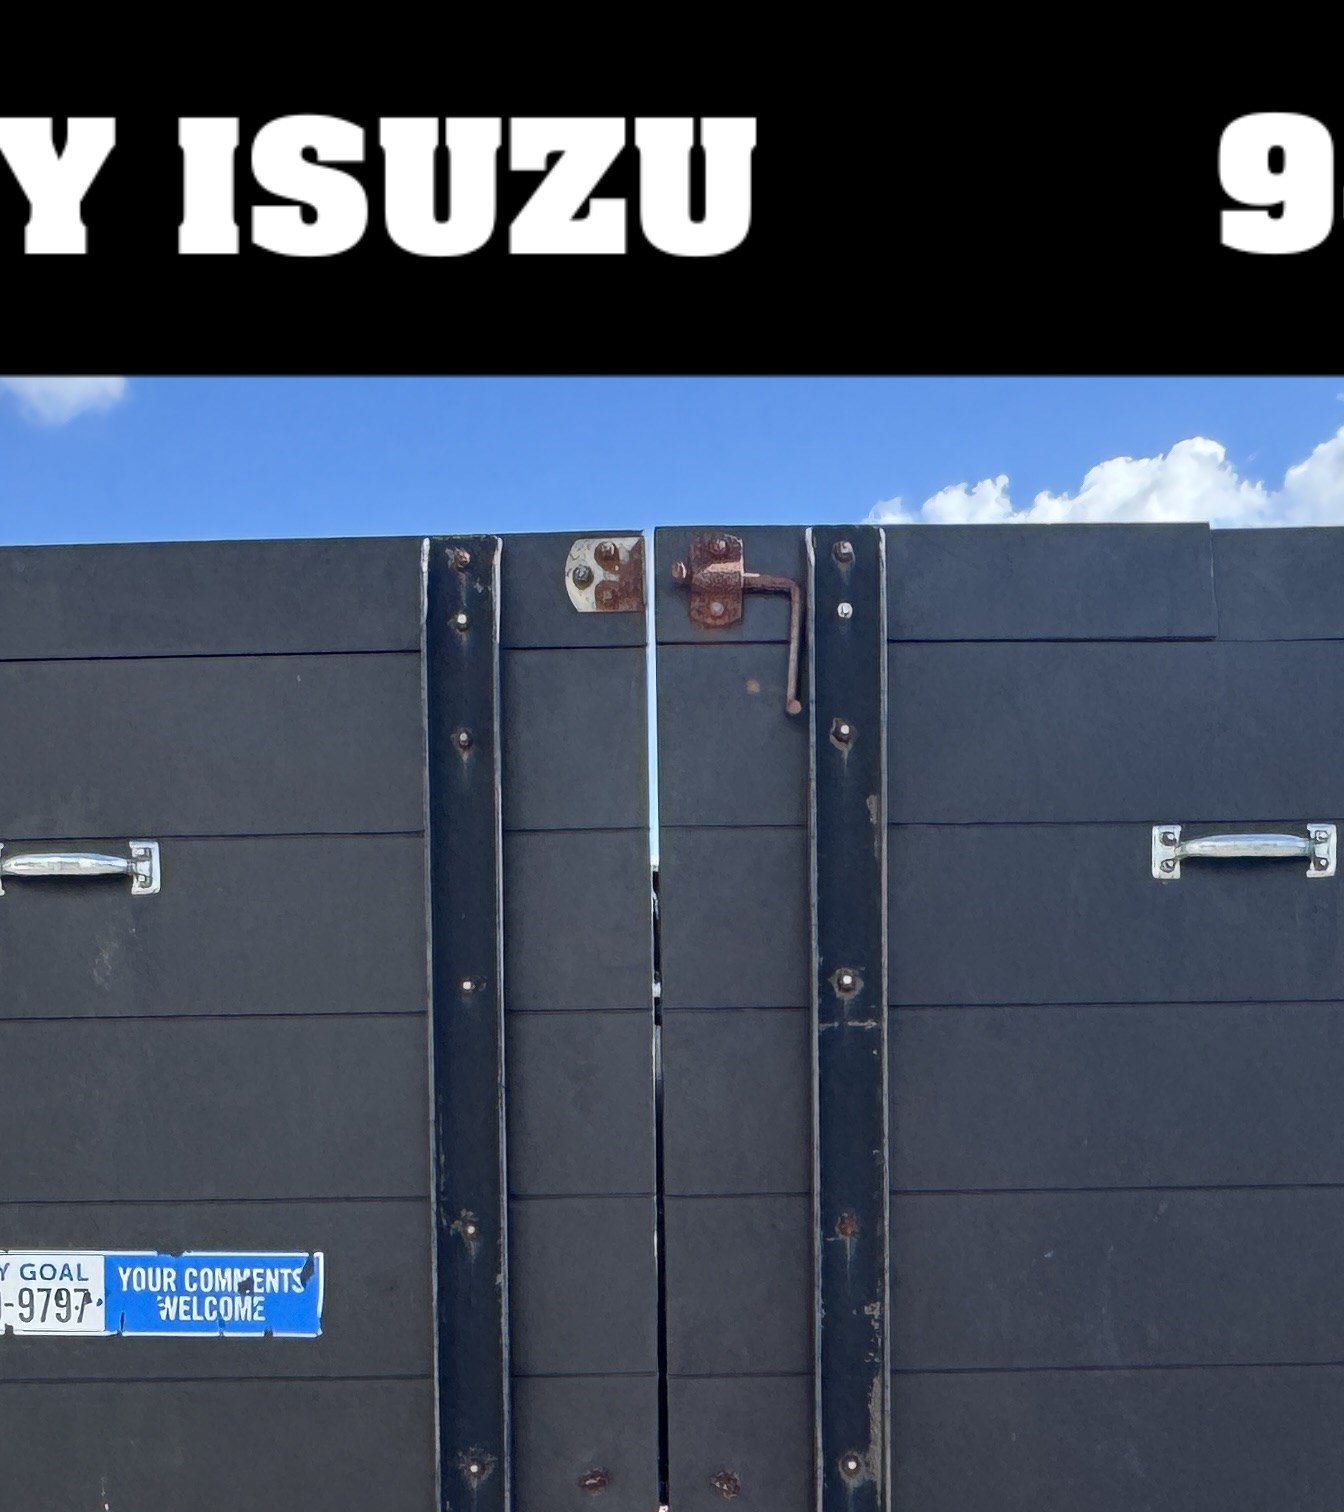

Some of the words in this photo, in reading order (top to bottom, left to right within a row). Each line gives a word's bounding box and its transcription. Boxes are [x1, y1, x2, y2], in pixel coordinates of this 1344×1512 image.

[19, 1263, 88, 1281] GOAL
[118, 1267, 176, 1292] YOUR
[158, 1296, 265, 1321] WELCOME
